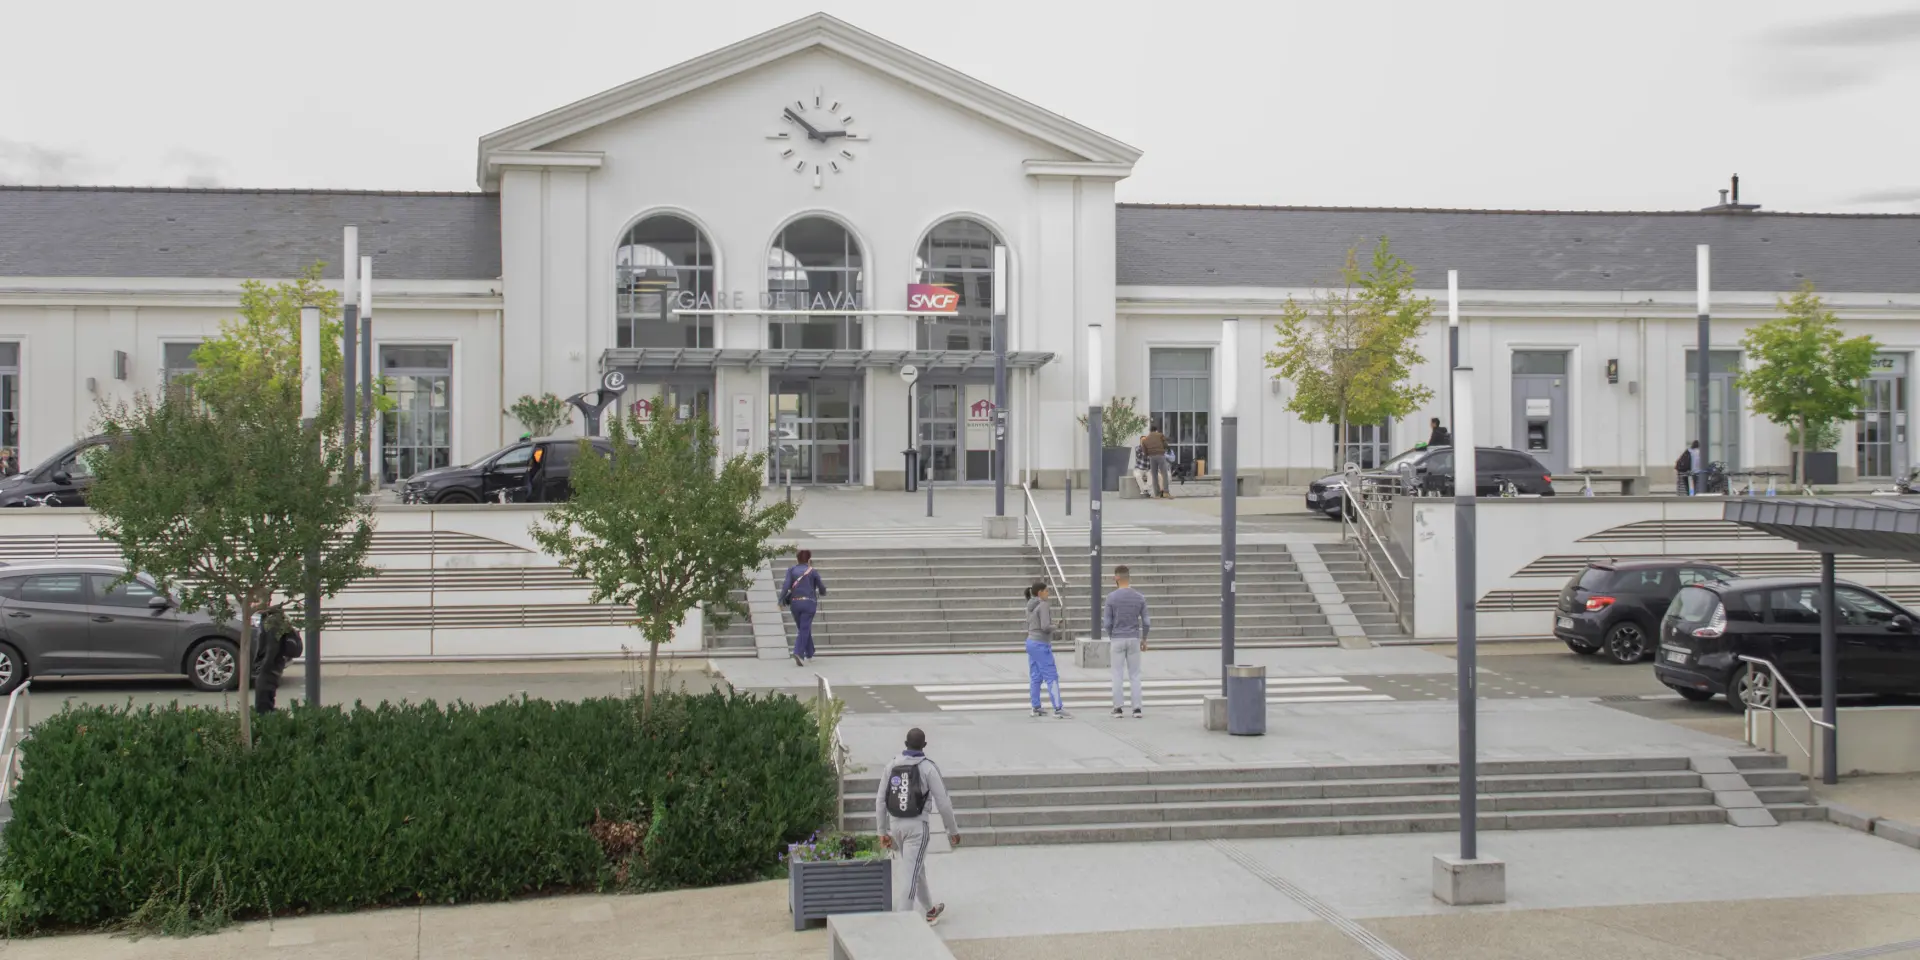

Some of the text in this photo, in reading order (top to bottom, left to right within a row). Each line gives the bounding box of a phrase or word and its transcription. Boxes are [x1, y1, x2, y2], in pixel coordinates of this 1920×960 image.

[677, 290, 868, 311] GARE DE LAVA
[908, 293, 956, 309] SNCF
[1871, 358, 1894, 368] ertz
[898, 772, 909, 812] adidas
